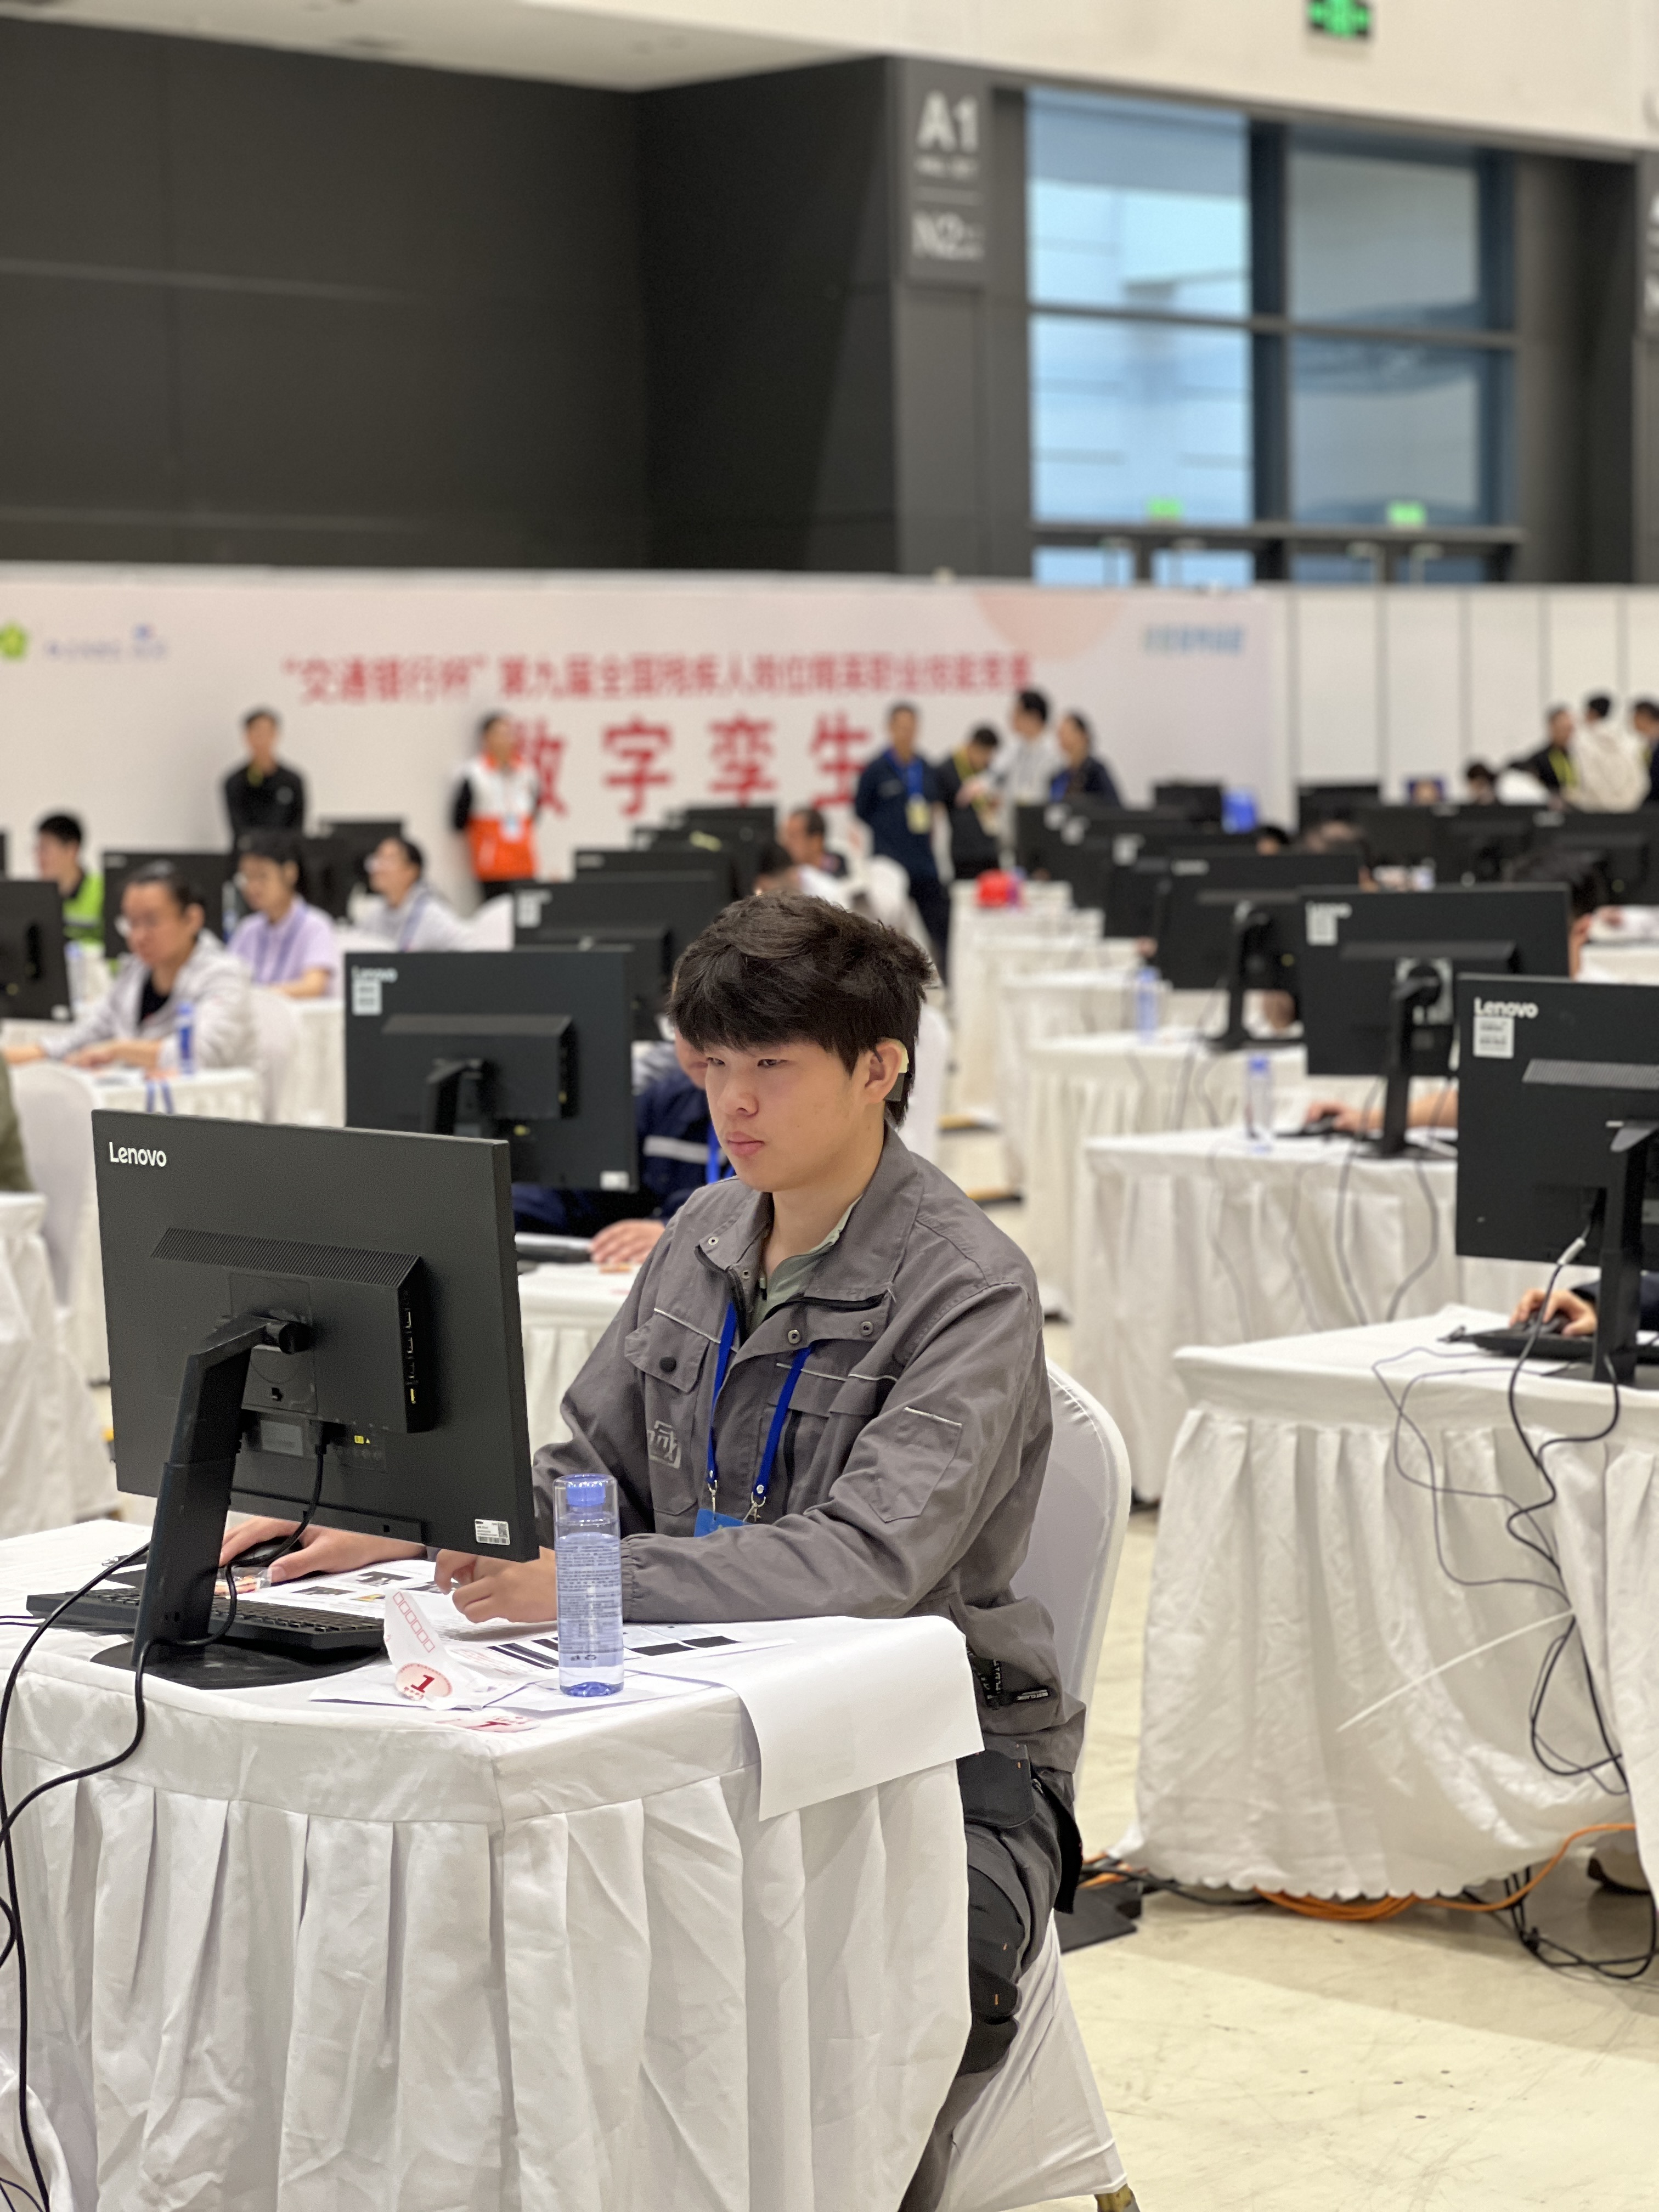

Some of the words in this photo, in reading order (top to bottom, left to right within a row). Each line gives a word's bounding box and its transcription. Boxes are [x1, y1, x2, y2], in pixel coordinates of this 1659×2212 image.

[915, 89, 979, 153] A1
[1474, 996, 1539, 1019] Lenovo
[109, 1142, 167, 1167] Lenovo
[410, 1674, 435, 1694] 1
